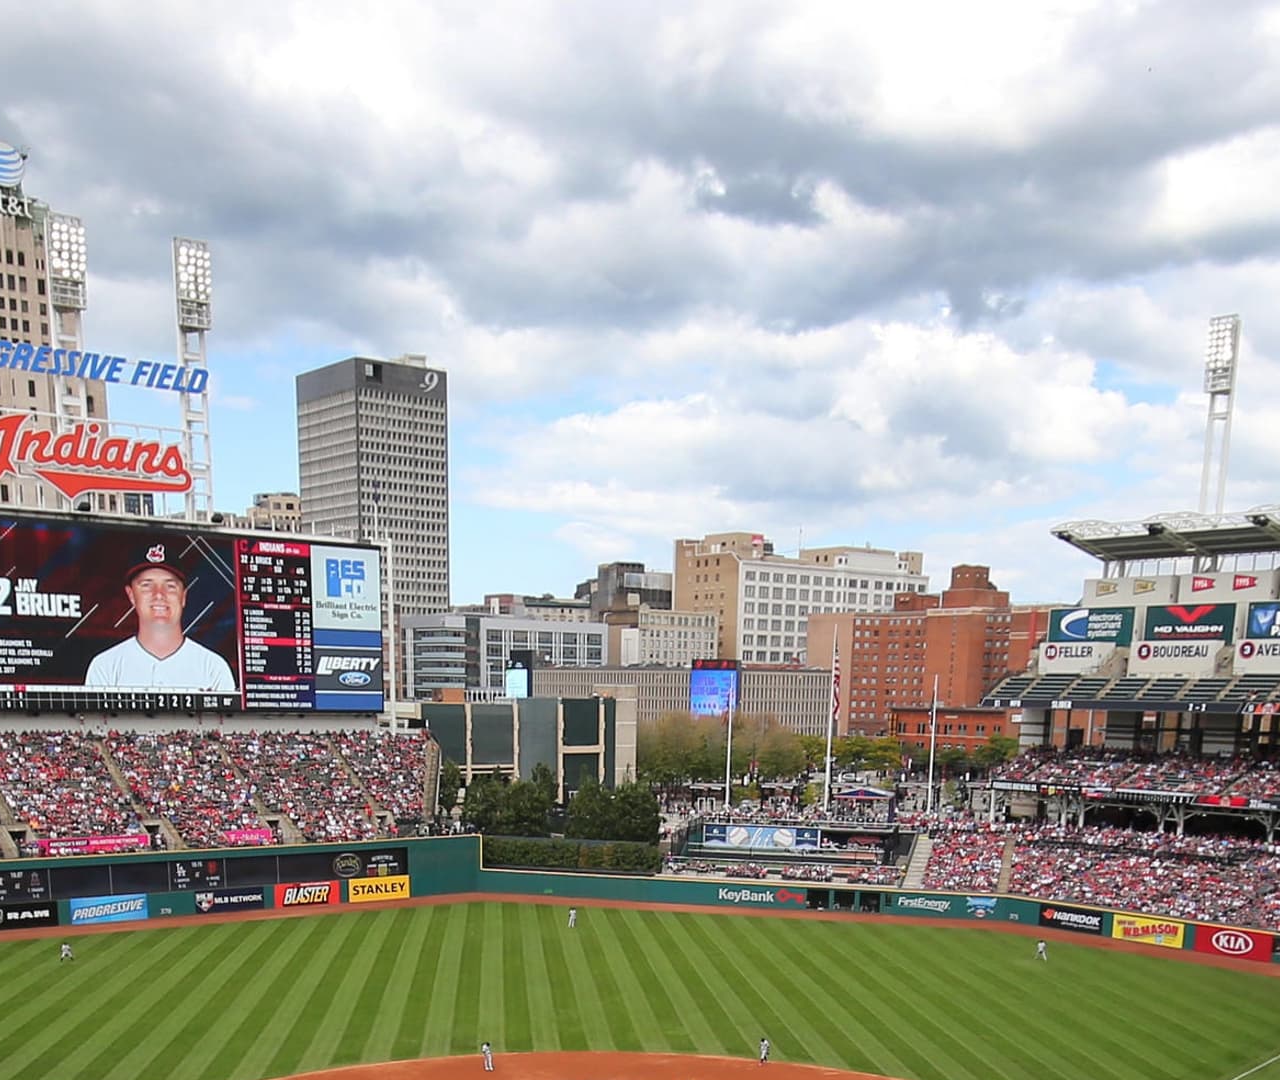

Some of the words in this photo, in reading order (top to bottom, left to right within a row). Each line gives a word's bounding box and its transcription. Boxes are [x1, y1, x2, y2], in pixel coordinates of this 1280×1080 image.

[131, 360, 210, 394] FIELD
[258, 542, 285, 553] INDIANS
[14, 579, 38, 593] JAY
[15, 592, 82, 618] BRUCE
[316, 601, 347, 610] Brilliant
[349, 602, 377, 611] Electric
[332, 611, 348, 620] Sign
[1088, 613, 1123, 621] electronic
[1087, 621, 1122, 629] merchant
[1175, 624, 1224, 633] VAUGHN
[1058, 646, 1094, 658] FELLER
[1152, 645, 1209, 657] BOUDREAU
[316, 656, 380, 675] LIBERTY
[158, 695, 164, 707] 2
[172, 695, 178, 707] 2
[185, 695, 192, 707] 2
[283, 885, 330, 905] BLASTER
[352, 882, 406, 896] STANLEY
[214, 896, 229, 904] MLB
[230, 893, 262, 903] NETWORK
[718, 888, 775, 903] KeyBank
[7, 909, 50, 921] RAM
[72, 899, 145, 921] PROGRESSIVE
[1219, 935, 1245, 949] KIA
